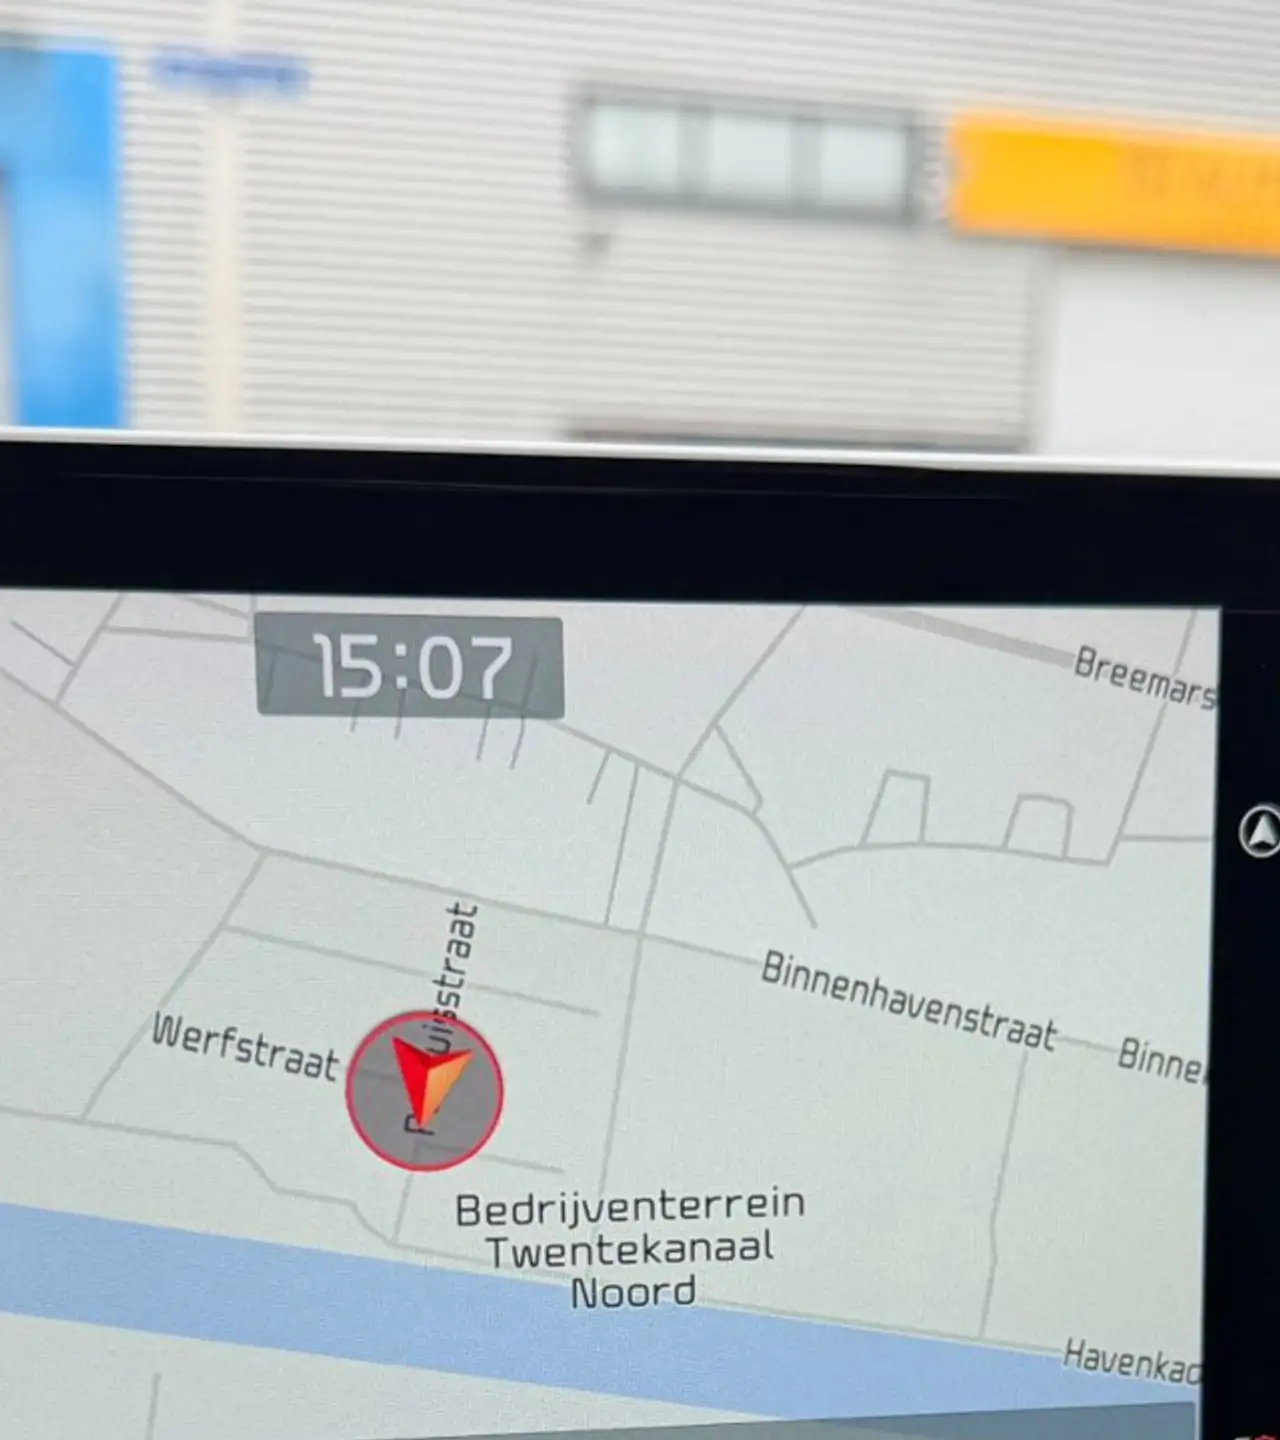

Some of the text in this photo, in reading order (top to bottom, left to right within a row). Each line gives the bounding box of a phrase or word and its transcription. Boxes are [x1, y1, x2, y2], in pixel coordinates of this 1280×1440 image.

[313, 633, 513, 700] 15:07
[761, 950, 1059, 1052] Binnenhavenstraat
[152, 1010, 341, 1082] Werfstraat
[1118, 1037, 1209, 1086] Binne
[456, 1186, 805, 1231] Bedrijventerrein
[485, 1228, 774, 1270] Twentekanaal
[570, 1274, 697, 1310] Noord
